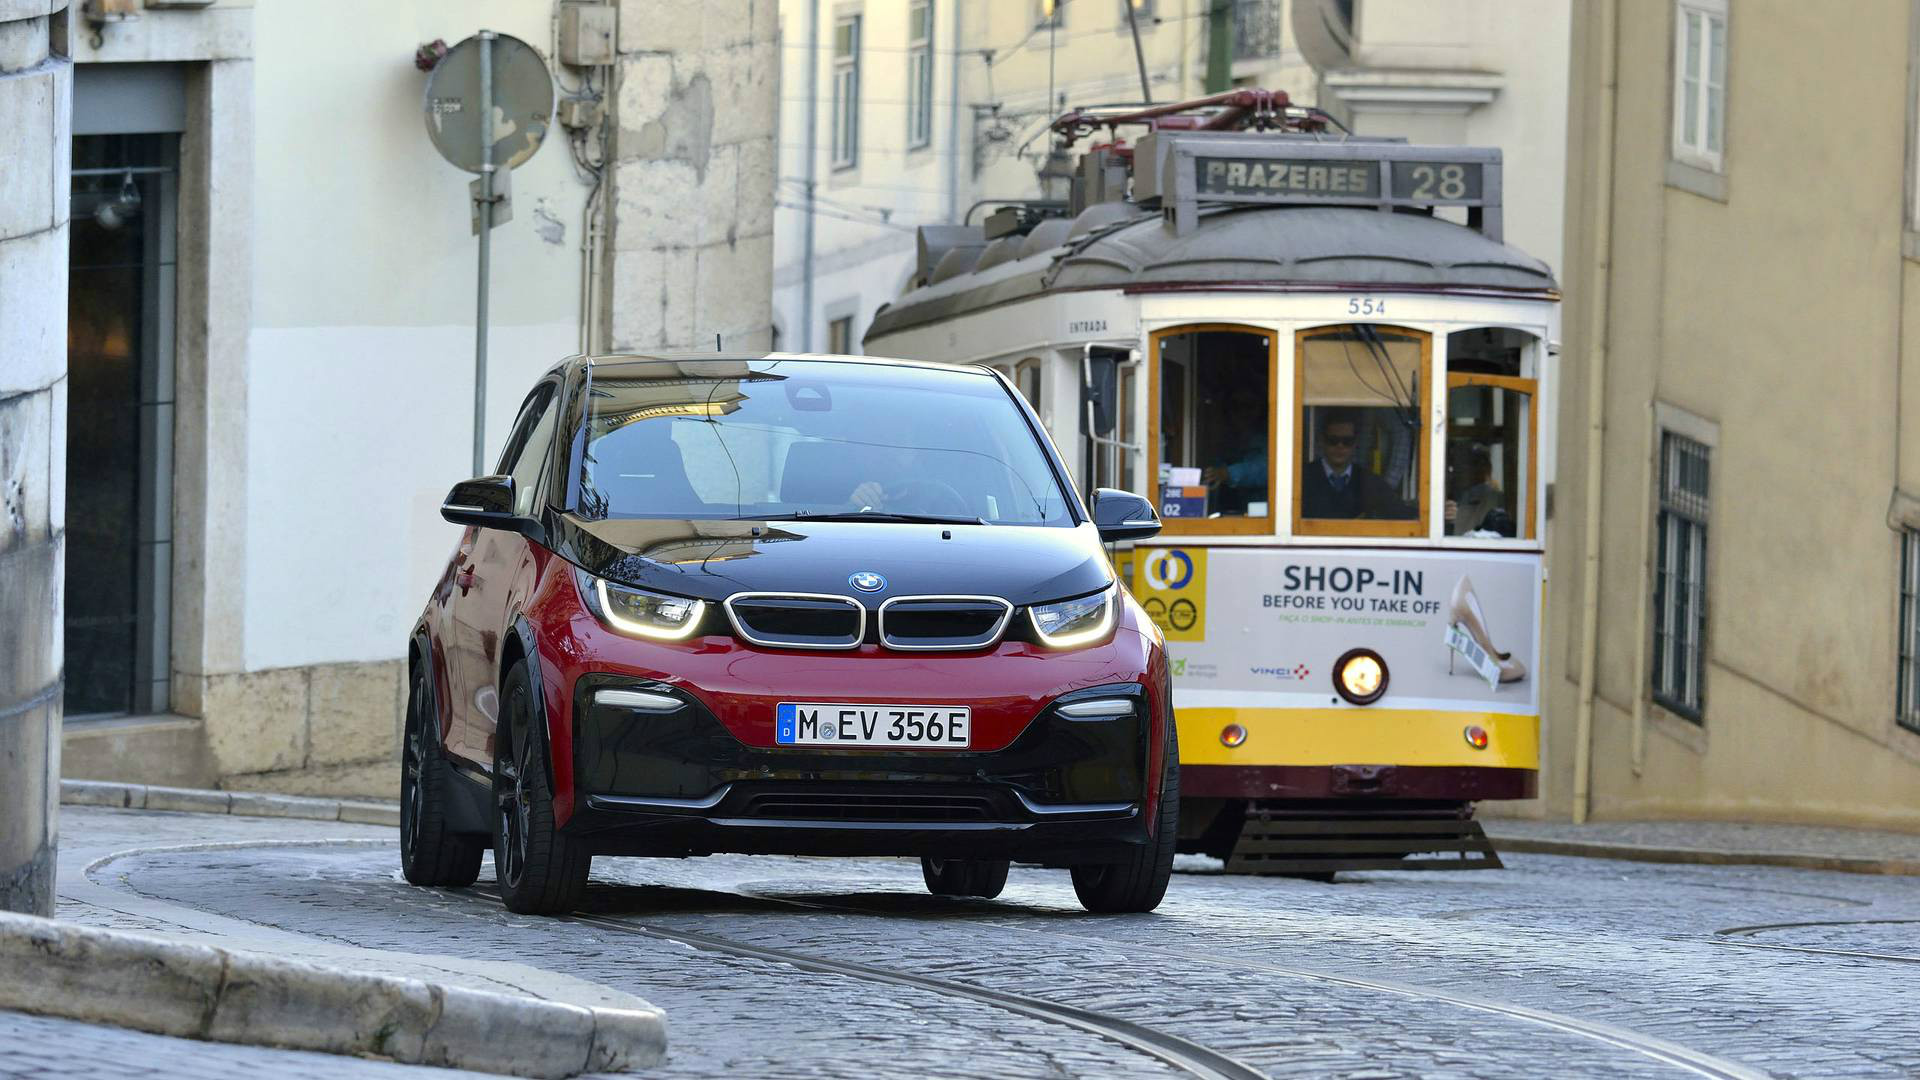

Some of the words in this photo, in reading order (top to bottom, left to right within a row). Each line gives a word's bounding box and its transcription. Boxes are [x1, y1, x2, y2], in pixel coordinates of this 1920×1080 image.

[1206, 161, 1369, 193] PRAZERES
[1411, 165, 1467, 200] 28
[1349, 298, 1386, 314] 554
[1069, 320, 1108, 333] ENTRADA
[1163, 503, 1181, 517] 02
[1283, 565, 1424, 596] SHOP-IN
[1262, 594, 1325, 610] BEFORE
[1331, 597, 1365, 611] YOU
[1369, 598, 1408, 613] TAKE
[1412, 601, 1440, 614] OFF
[1250, 667, 1290, 676] VINCI
[783, 728, 790, 737] D
[798, 710, 818, 740] M
[838, 710, 879, 740] EV
[887, 711, 967, 743] 356E
